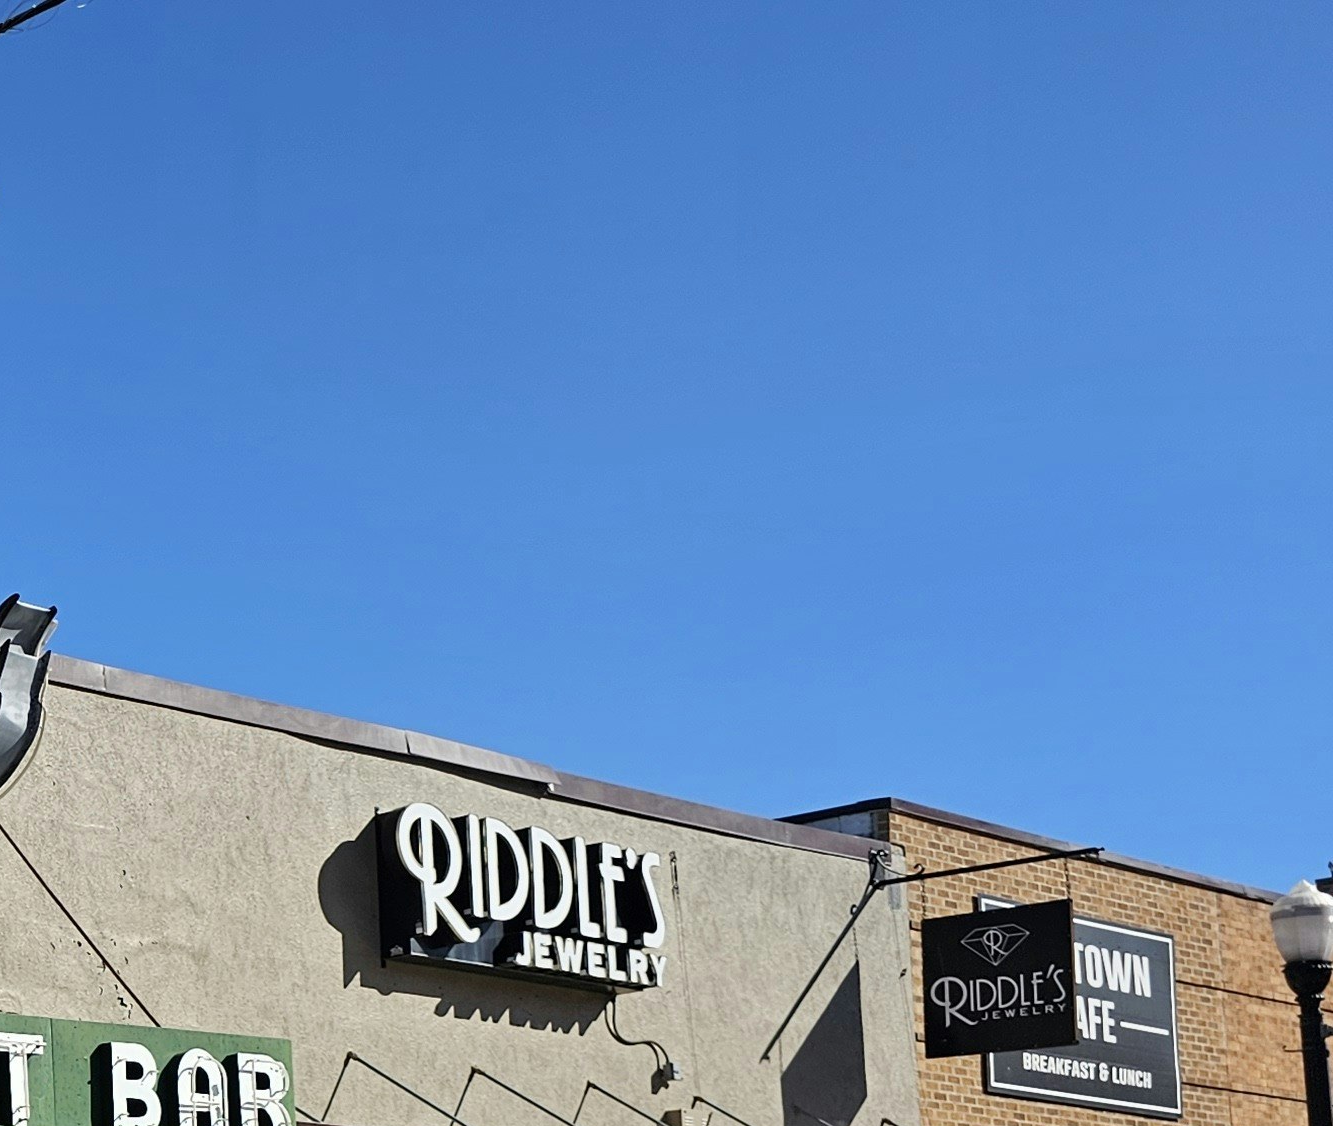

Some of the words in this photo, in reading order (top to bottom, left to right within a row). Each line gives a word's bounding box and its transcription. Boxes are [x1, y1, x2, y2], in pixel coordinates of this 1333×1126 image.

[396, 803, 665, 948] RIDDLE'S
[515, 931, 667, 987] JEWELRY
[1074, 941, 1152, 998] TOWN
[930, 964, 1067, 1028] RIDDLE'S
[981, 1003, 1067, 1021] JEWELRY
[1076, 995, 1117, 1044] AFE
[1022, 1052, 1097, 1081] BREAKFAST
[1098, 1062, 1109, 1082] &
[1112, 1066, 1152, 1090] LUNCH
